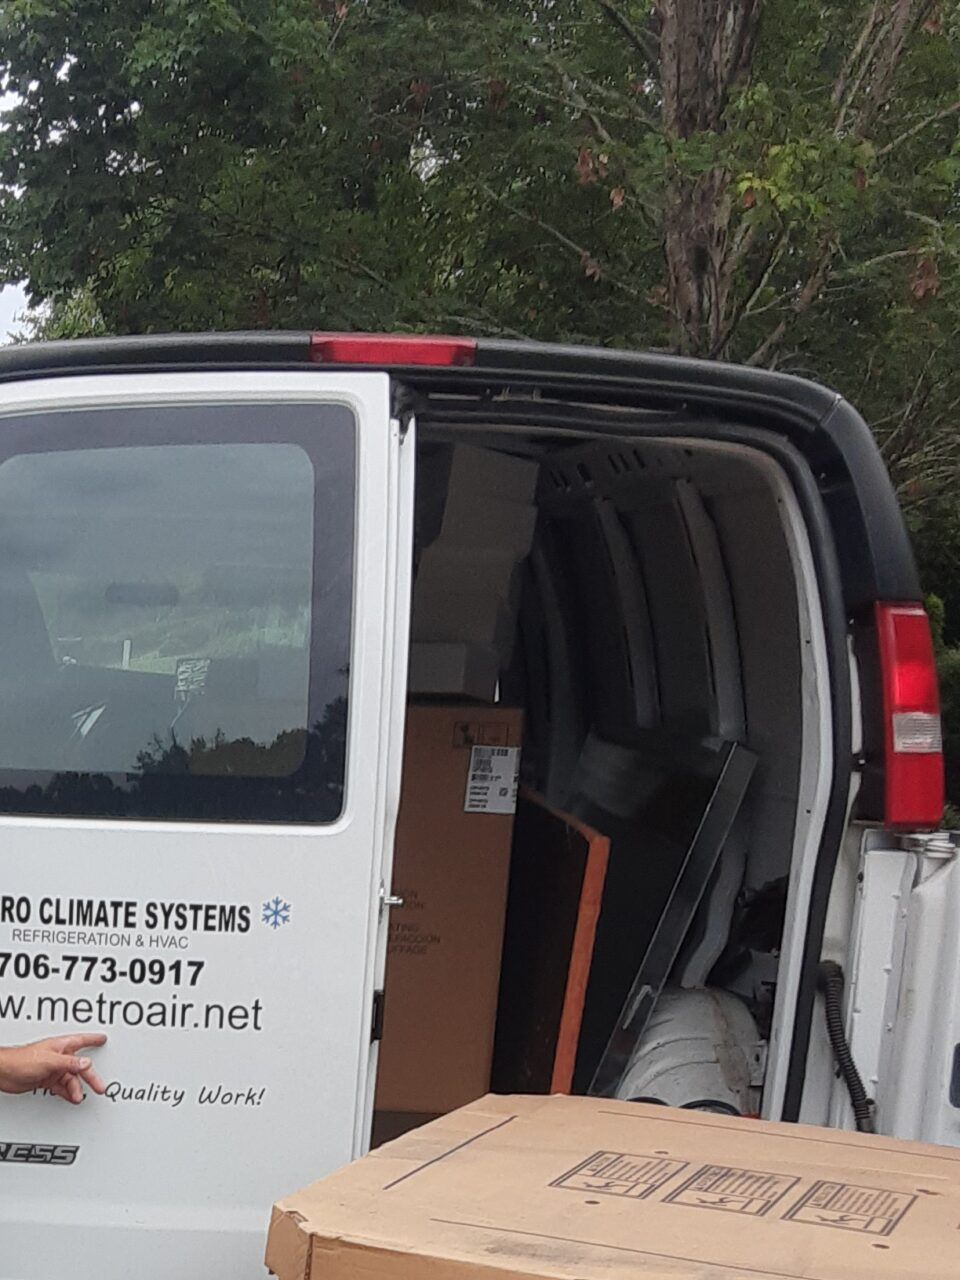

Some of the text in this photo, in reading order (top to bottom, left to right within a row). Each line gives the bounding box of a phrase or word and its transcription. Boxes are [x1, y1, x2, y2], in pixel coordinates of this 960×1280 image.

[39, 897, 138, 929] CLIMATE
[144, 901, 252, 933] SYSTEMS
[11, 928, 190, 950] REFRIGERATION & HVAC
[104, 1081, 186, 1108] Quality
[198, 1085, 266, 1106] Work!
